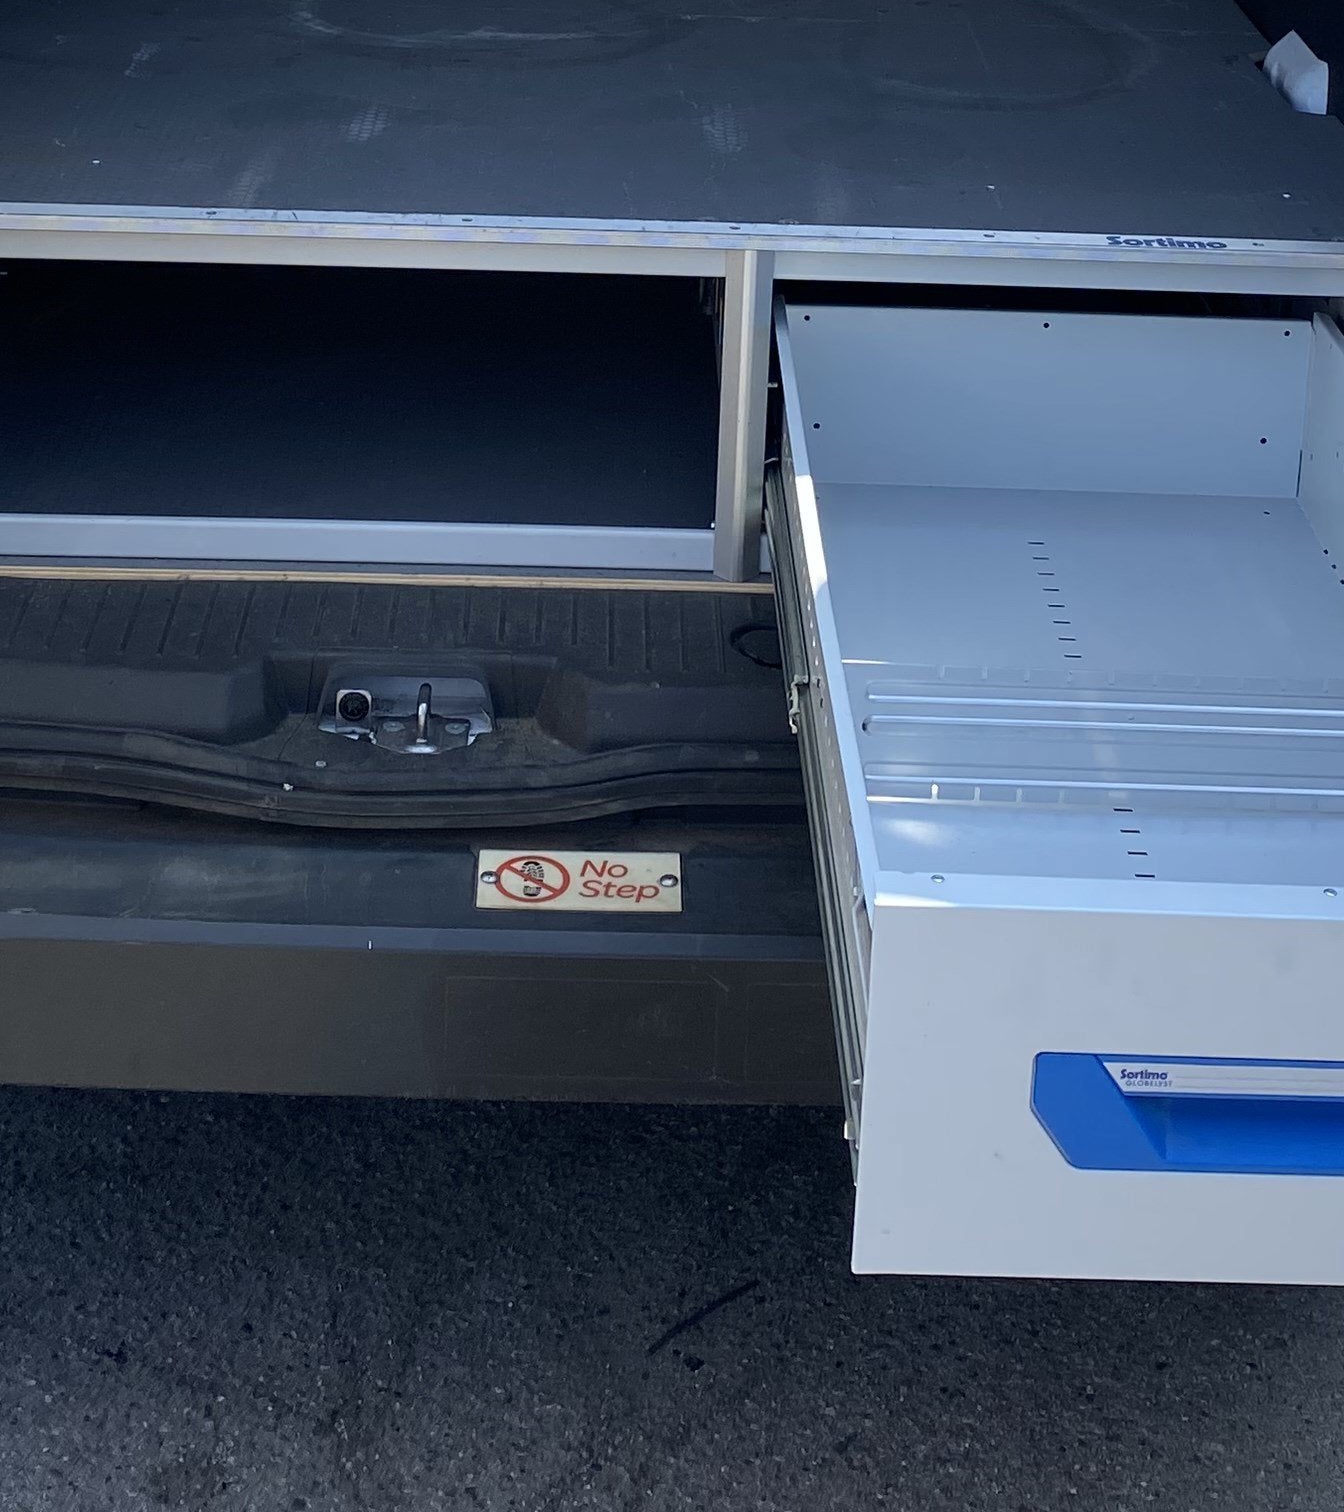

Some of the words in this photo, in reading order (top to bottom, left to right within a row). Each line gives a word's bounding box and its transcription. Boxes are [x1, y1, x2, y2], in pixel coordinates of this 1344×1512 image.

[1106, 236, 1228, 250] Sortimo
[579, 859, 629, 879] No
[578, 879, 660, 904] Step
[1120, 1068, 1169, 1080] Sortimo
